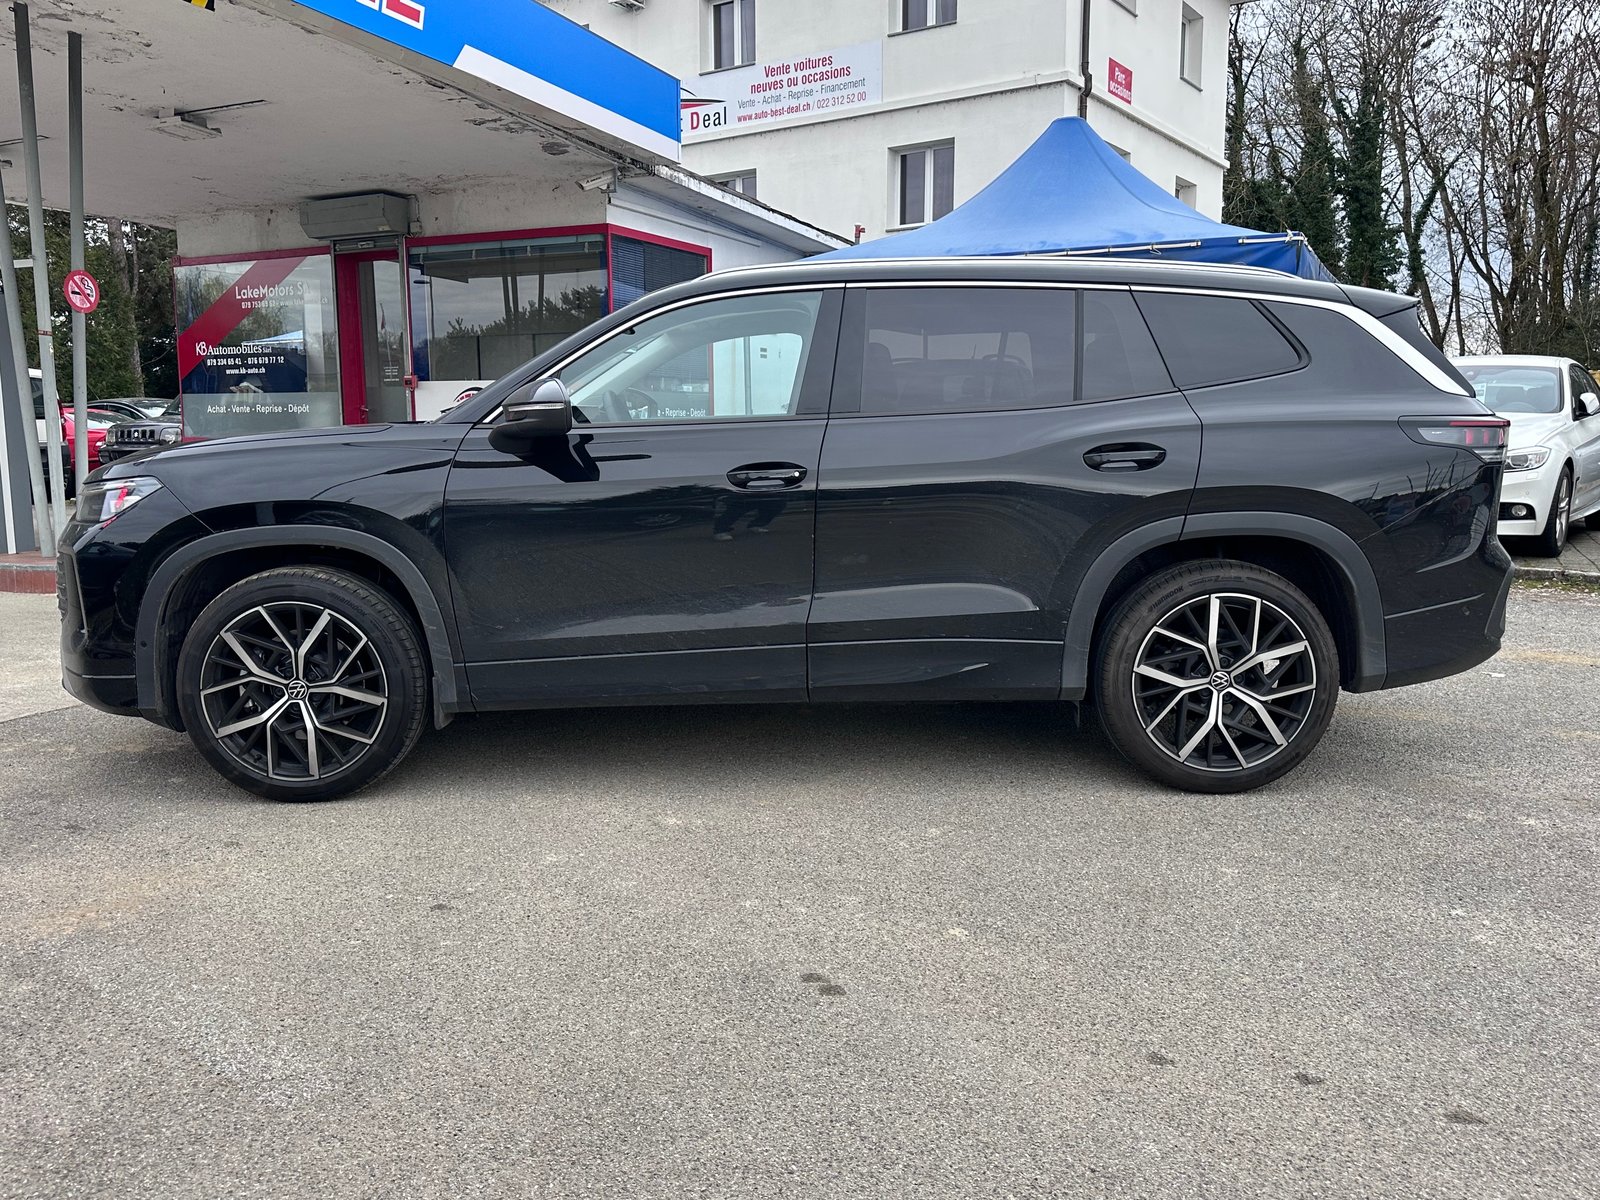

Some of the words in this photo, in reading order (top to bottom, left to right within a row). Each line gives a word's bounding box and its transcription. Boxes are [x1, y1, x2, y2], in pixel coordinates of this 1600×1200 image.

[764, 63, 791, 78] Vente
[793, 55, 833, 72] voitures
[1115, 66, 1126, 84] Parc
[750, 79, 784, 94] neuves
[787, 75, 798, 87] ou
[801, 66, 851, 85] occasions
[737, 98, 756, 109] Vente
[762, 94, 782, 105] Achat
[788, 87, 814, 101] Reprise
[820, 77, 866, 94] Financement
[1110, 80, 1131, 102] occasions
[737, 102, 811, 123] www.auto-best-deal.ch
[816, 98, 830, 109] 022
[831, 95, 845, 106] 312
[846, 93, 855, 104] 52
[857, 91, 867, 102] 00
[690, 106, 727, 130] Deal
[235, 284, 294, 299] LakeMotors
[207, 358, 217, 366] 079
[217, 358, 227, 366] 334
[235, 357, 242, 365] 41
[247, 357, 258, 365] 076
[269, 356, 276, 364] 77
[277, 356, 285, 364] 12
[225, 366, 266, 375] www.kb-auto.ch
[207, 404, 226, 413] Achat
[231, 404, 250, 413] Vente
[256, 404, 283, 414] Reprise
[288, 403, 309, 415] Dépôt
[665, 408, 687, 418] Reprise
